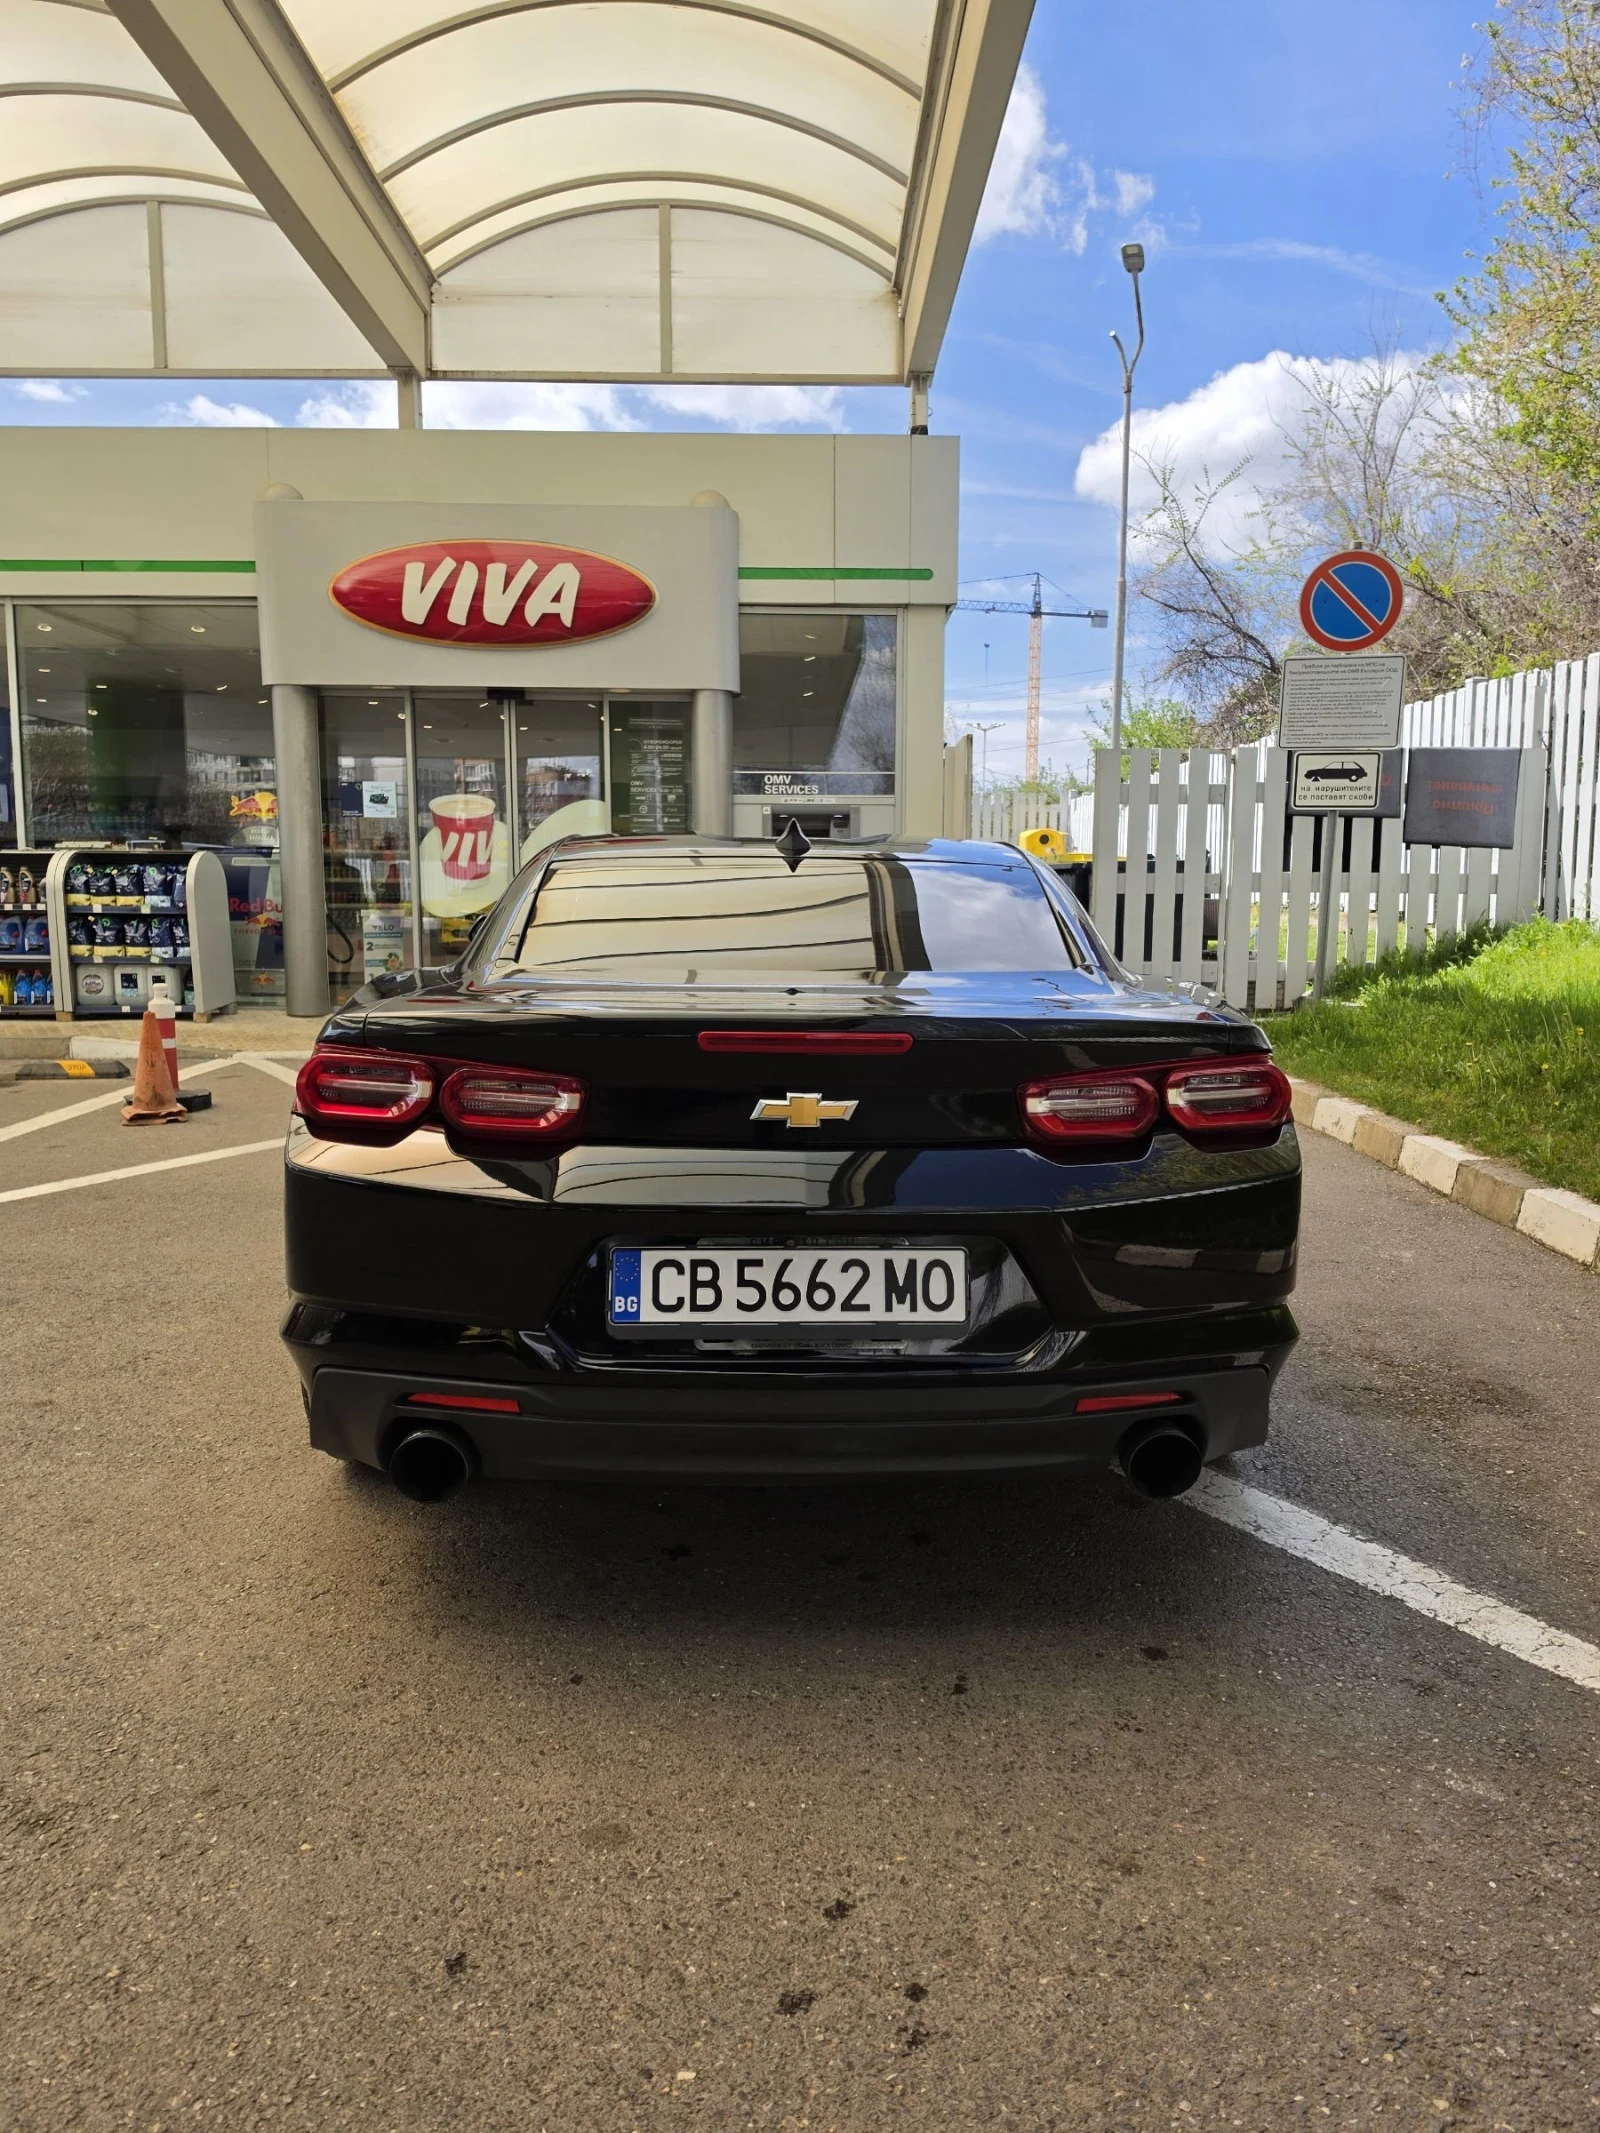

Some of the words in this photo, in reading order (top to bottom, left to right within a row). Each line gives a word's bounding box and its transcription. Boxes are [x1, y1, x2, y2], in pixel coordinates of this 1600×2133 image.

[402, 556, 581, 628] VIVA
[764, 775, 792, 784] OMV
[764, 785, 819, 795] SERVICES
[1315, 785, 1372, 793] нарушителите
[230, 896, 261, 913] Red
[263, 898, 283, 913] Bu
[366, 941, 374, 951] 2
[67, 1064, 86, 1072] STOP
[651, 1258, 723, 1313] CB
[736, 1258, 871, 1313] 5662
[884, 1258, 955, 1313] MO
[614, 1296, 638, 1313] BG
